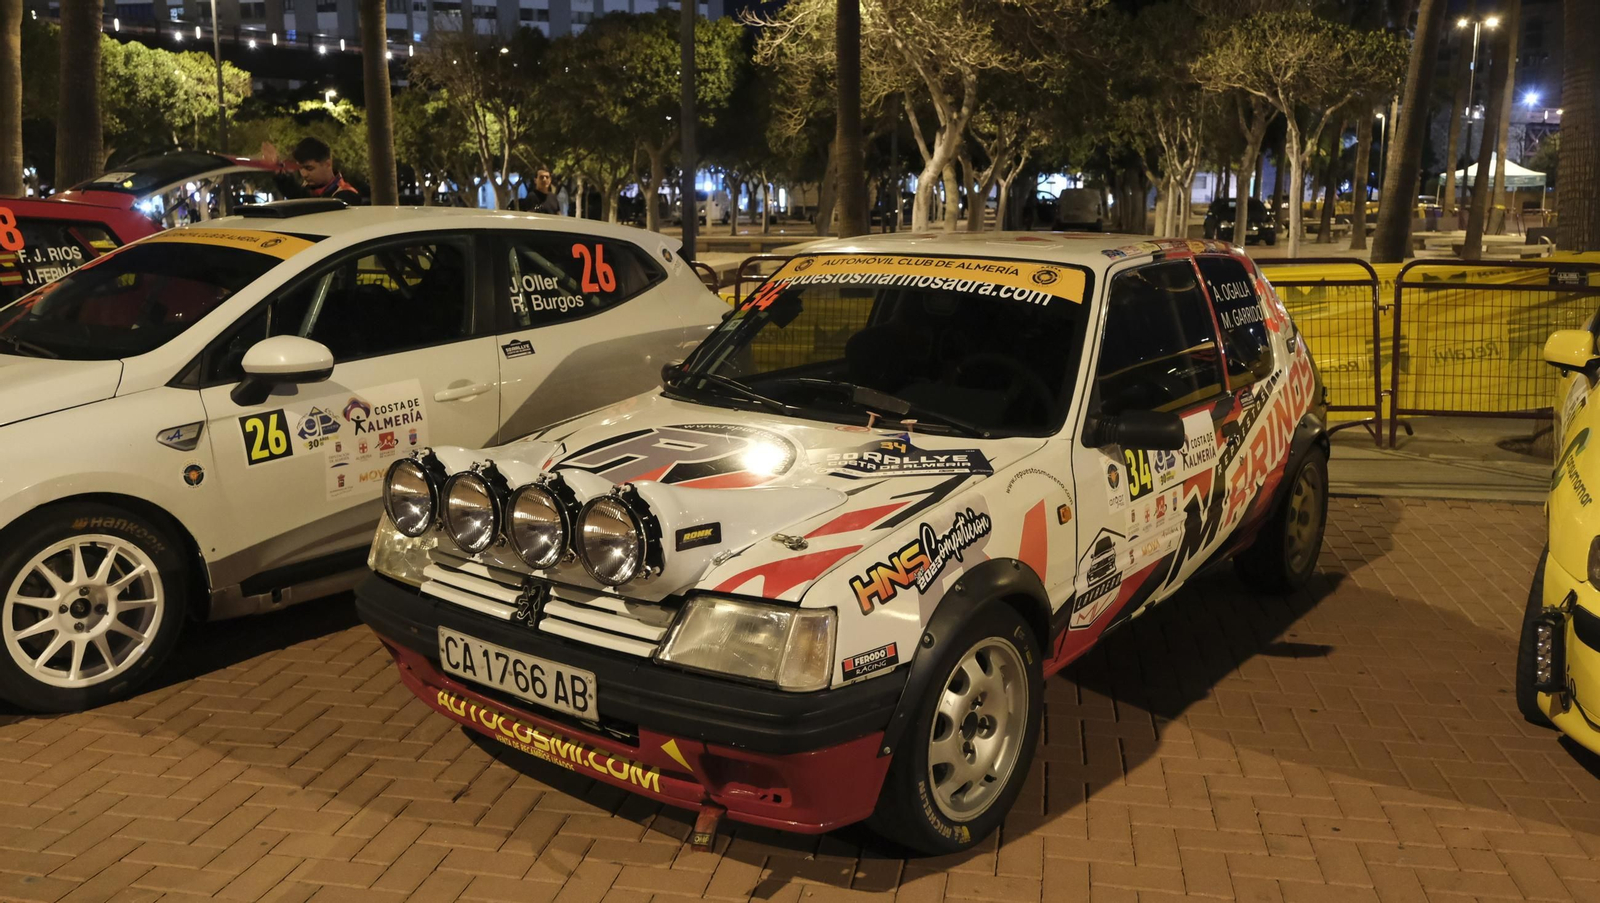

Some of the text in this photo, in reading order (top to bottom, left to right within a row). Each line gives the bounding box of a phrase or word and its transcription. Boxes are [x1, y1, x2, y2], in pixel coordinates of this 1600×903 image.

[17, 246, 82, 264] F. J. RIOS
[572, 243, 616, 292] 26
[821, 256, 1019, 276] AUTOMÓVIL CLUB DE ALMERÍA
[1221, 281, 1251, 300] OGALLA
[532, 294, 584, 313] Burgos
[1220, 304, 1264, 329] M. GARRIDO
[374, 398, 420, 416] COSTA DE
[367, 408, 423, 433] ALMERÍA
[245, 414, 288, 460] 26
[308, 439, 319, 450] 30
[1190, 432, 1214, 449] COSTA DE
[880, 441, 907, 454] 34
[1188, 444, 1217, 468] ALMERÍA
[827, 460, 876, 470] COSTA
[903, 461, 972, 469] ALMERÍA
[863, 451, 969, 465] RALLYE
[1124, 449, 1152, 496] 34
[851, 541, 932, 612] HNS
[917, 554, 946, 591] 2023
[854, 649, 887, 667] FERODO
[445, 636, 589, 713] CA 1766 AB
[855, 660, 888, 676] RACING
[437, 689, 661, 793] AUTOCOSMI.COM
